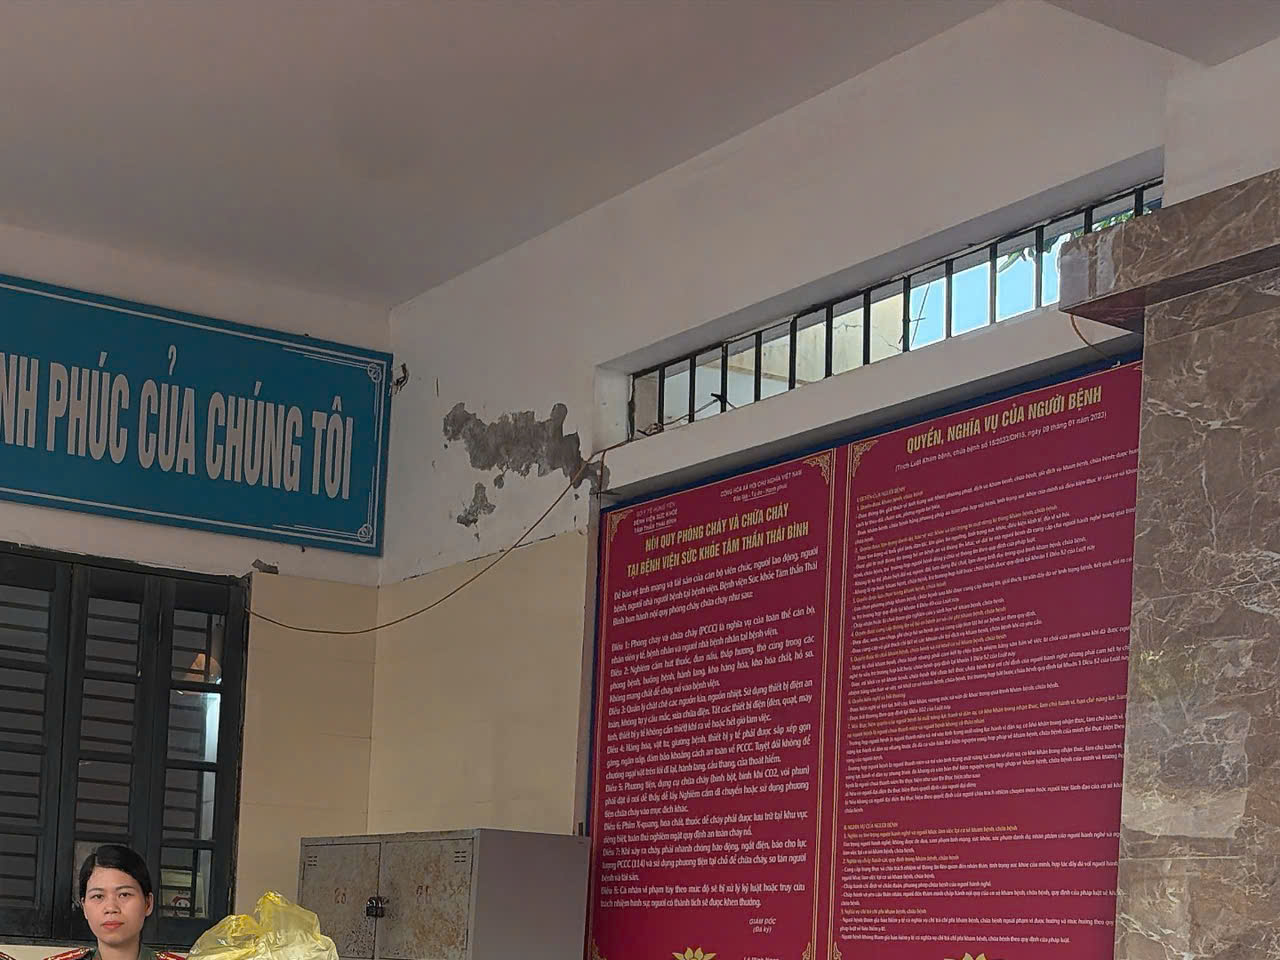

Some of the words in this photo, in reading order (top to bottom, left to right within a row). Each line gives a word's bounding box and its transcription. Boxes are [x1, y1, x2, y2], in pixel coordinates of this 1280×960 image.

[47, 352, 129, 464] PHÚC
[138, 345, 196, 475] CỦA
[206, 381, 303, 492] CHÚNG
[311, 396, 353, 499] TÔI
[984, 413, 997, 435] VỤ
[1001, 403, 1024, 427] CỦA
[1027, 395, 1064, 420] NGƯỜI
[1068, 384, 1101, 411] BỆNH
[660, 532, 674, 548] QUY
[677, 523, 704, 543] PHÒNG
